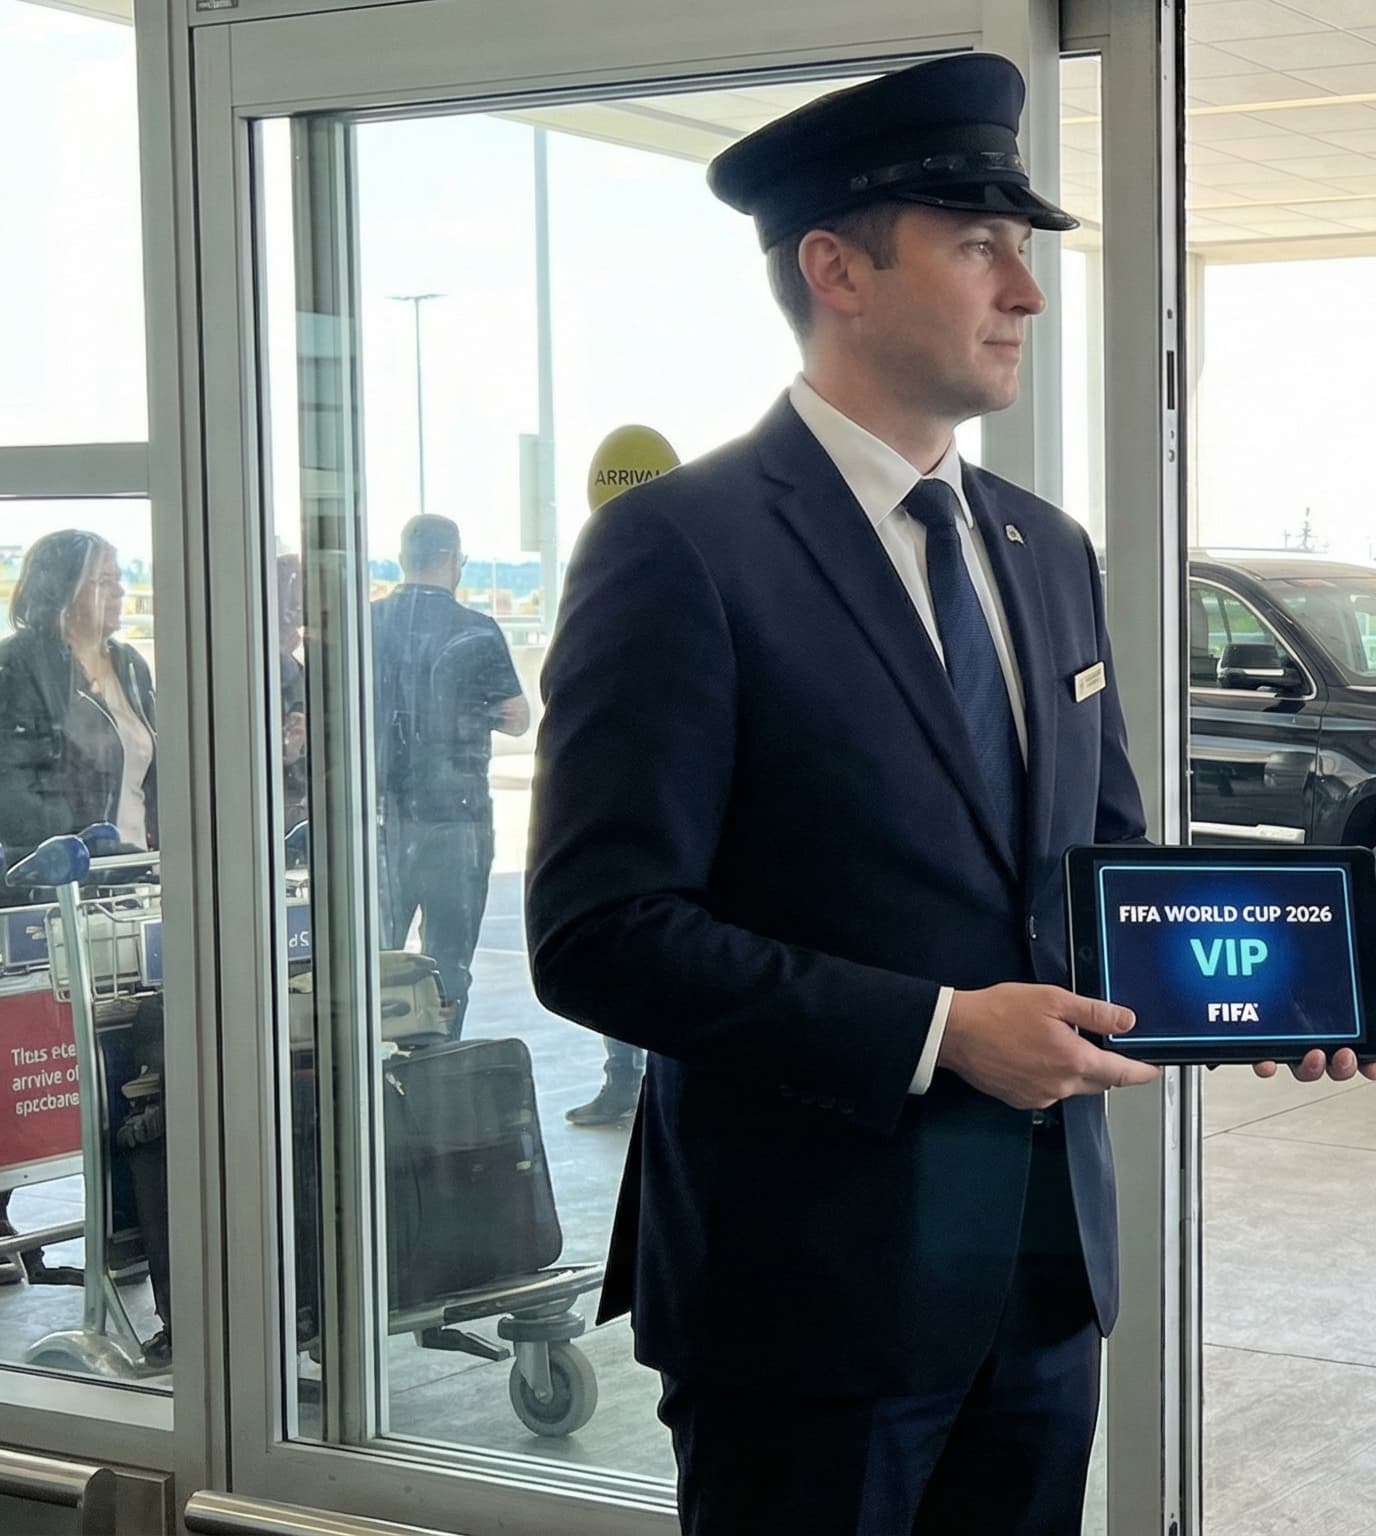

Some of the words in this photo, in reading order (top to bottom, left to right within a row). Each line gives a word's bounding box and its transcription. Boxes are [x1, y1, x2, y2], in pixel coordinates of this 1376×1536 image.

[1119, 905, 1161, 922] FIFA
[1164, 905, 1238, 922] WORLD
[1242, 905, 1281, 922] CUP
[1285, 905, 1333, 922] 2026
[1189, 938, 1268, 976] VIP
[1208, 1003, 1259, 1022] FIFA
